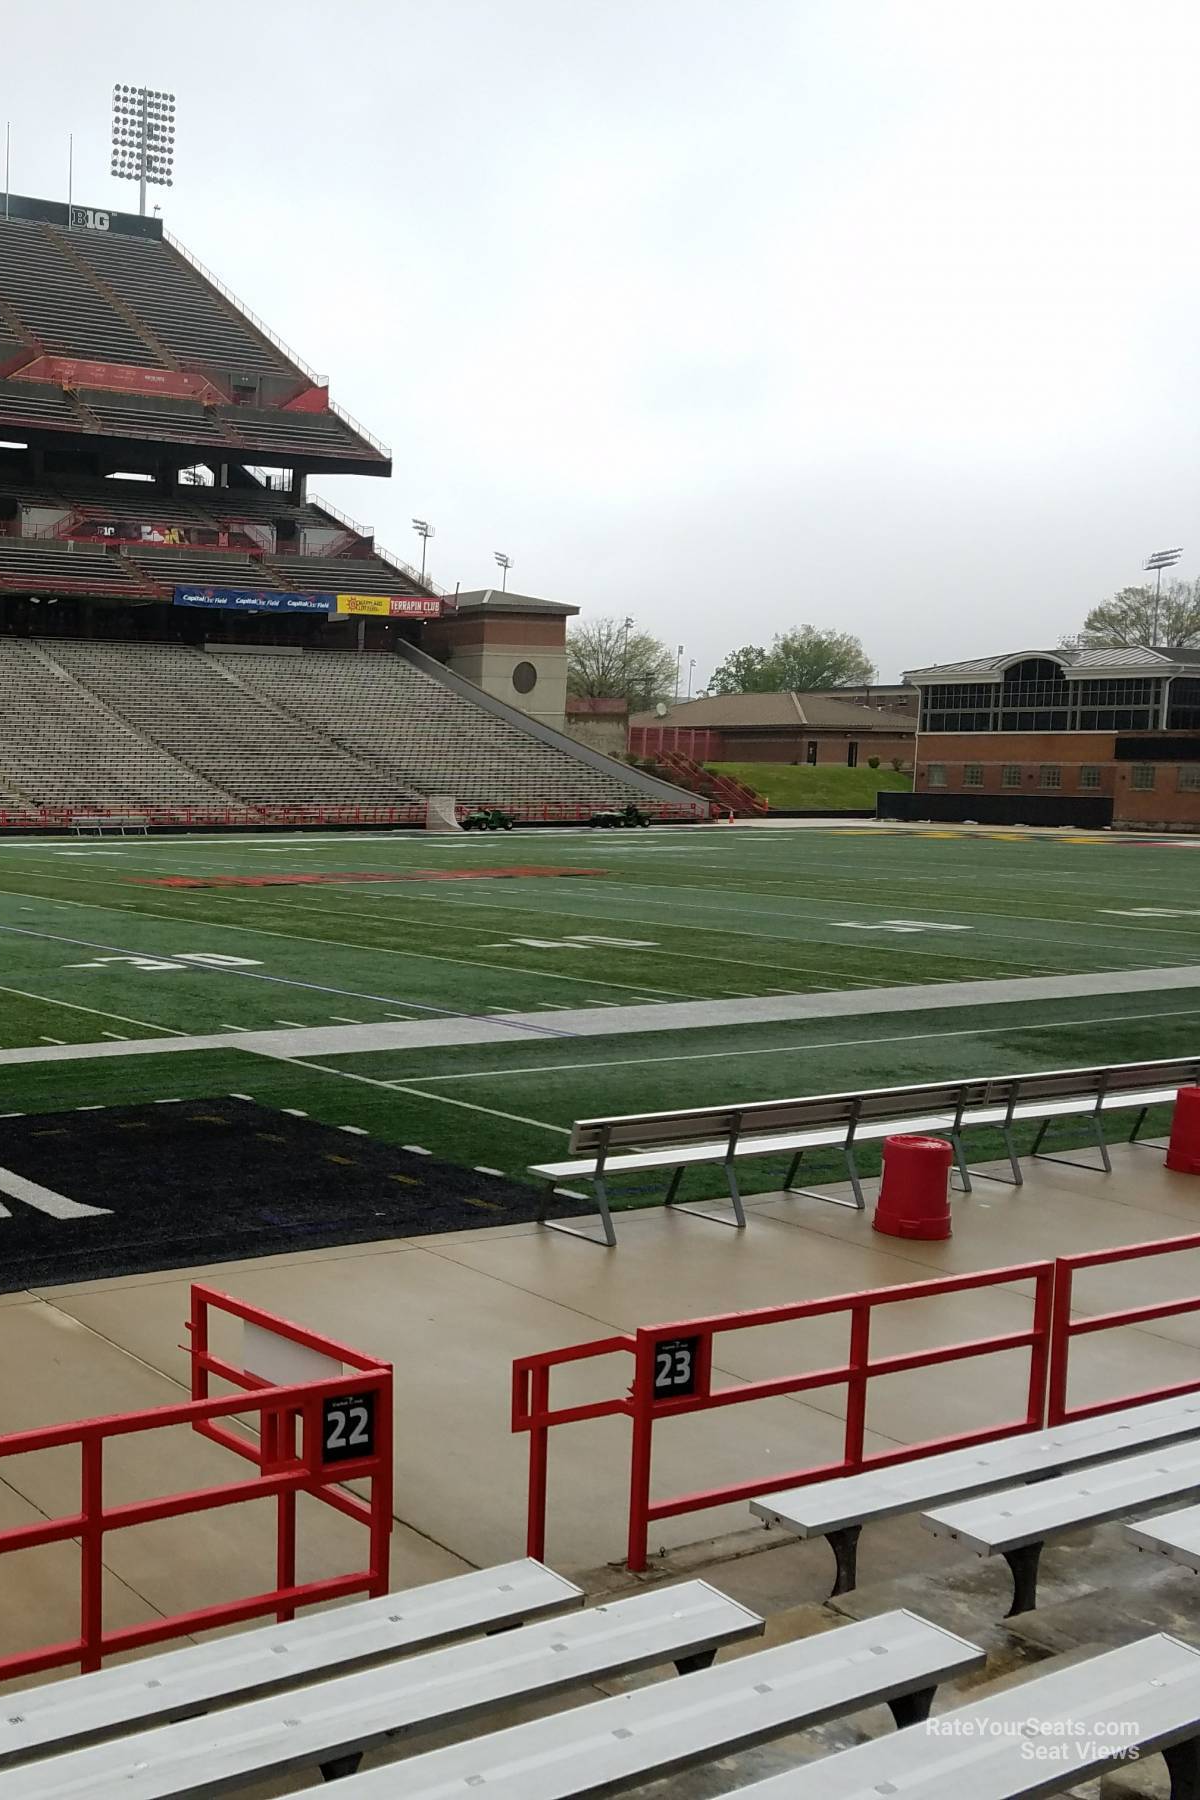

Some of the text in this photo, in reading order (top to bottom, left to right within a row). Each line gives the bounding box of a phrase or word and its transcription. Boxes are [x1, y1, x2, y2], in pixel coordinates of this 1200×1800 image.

[391, 600, 440, 611] TERRAPIN CLUB
[655, 1350, 691, 1387] 23
[326, 1406, 369, 1449] 22
